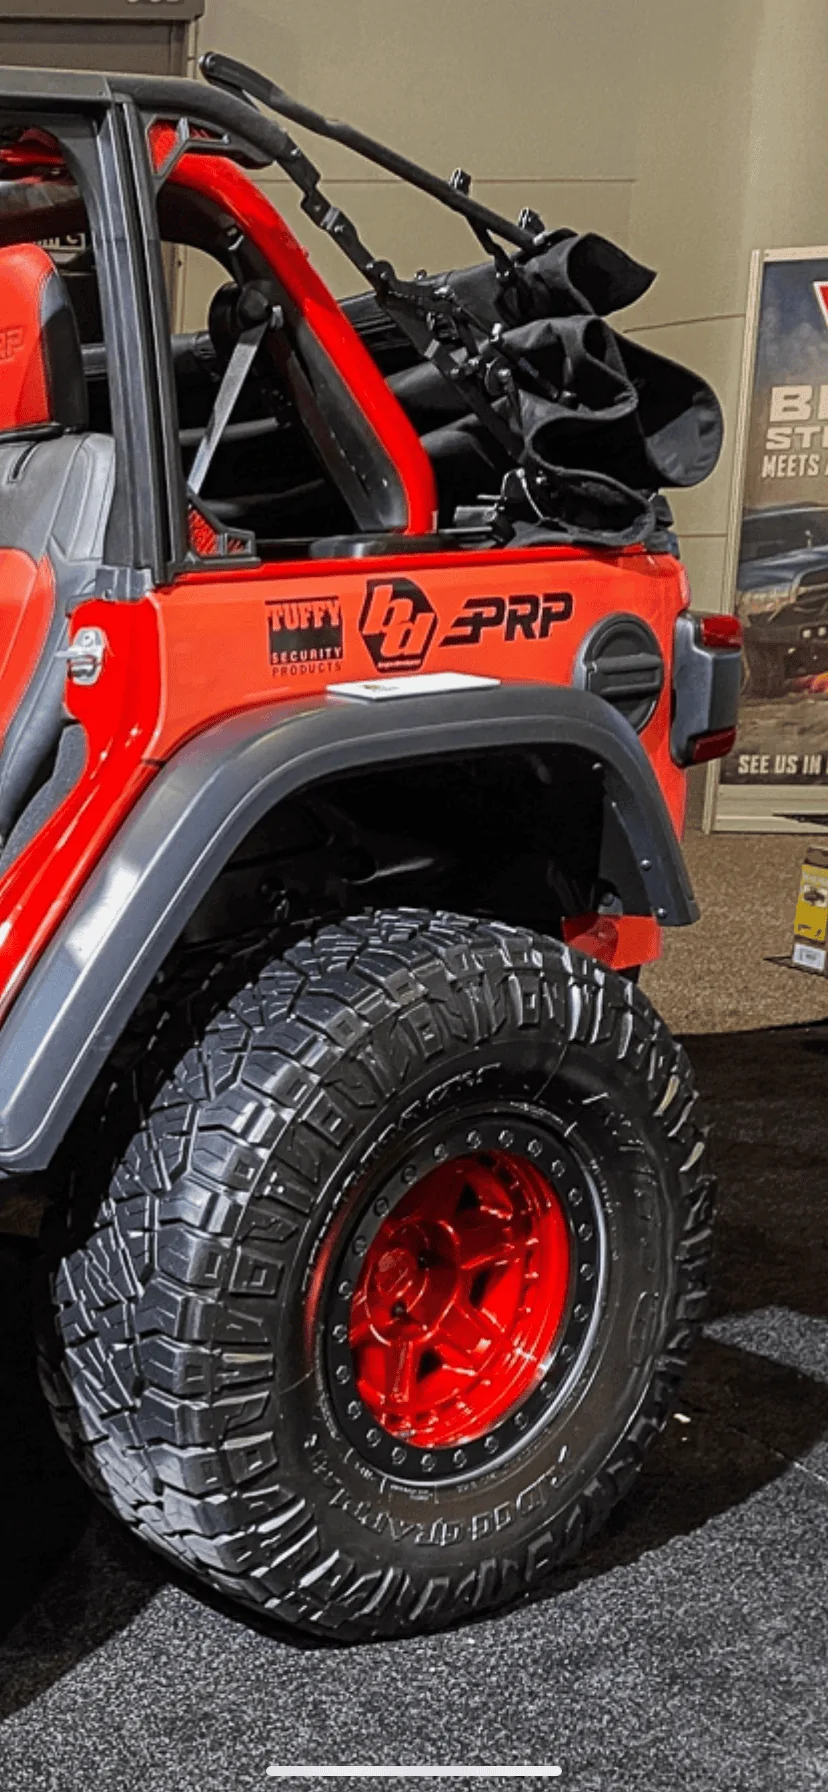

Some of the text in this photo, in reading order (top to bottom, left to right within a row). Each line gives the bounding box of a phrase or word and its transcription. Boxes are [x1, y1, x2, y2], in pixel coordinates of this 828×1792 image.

[769, 384, 828, 423] B
[762, 454, 820, 478] MEETS
[265, 600, 341, 632] TUFFY
[272, 646, 342, 664] SECURITY
[272, 660, 342, 677] PRODUCTS
[738, 754, 823, 775] SEE US IN
